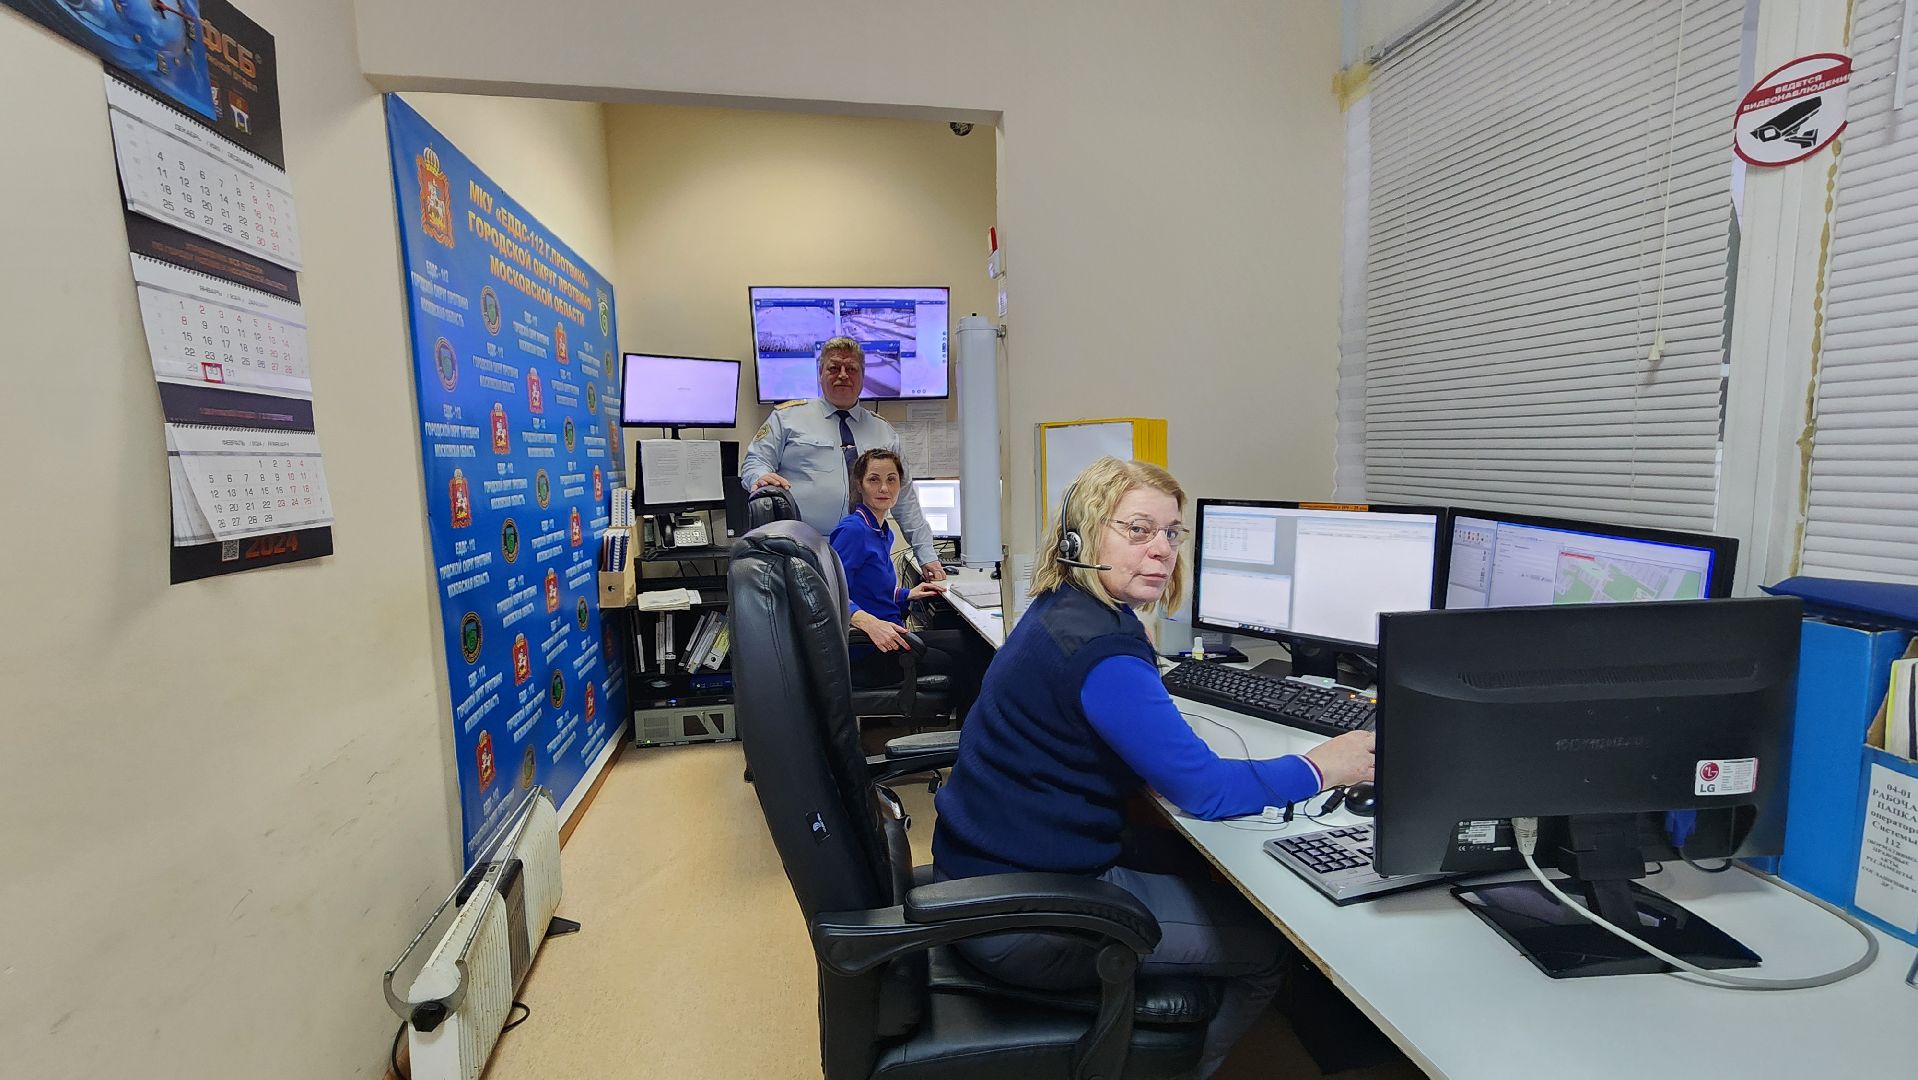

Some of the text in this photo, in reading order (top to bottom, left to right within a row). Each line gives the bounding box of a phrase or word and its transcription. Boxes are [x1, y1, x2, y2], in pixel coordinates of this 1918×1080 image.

[1743, 74, 1850, 111] ВИДЕОНАБЛЮДЕНИ
[1775, 74, 1823, 94] ВЕДЕТСЯ
[469, 179, 493, 214] МКУ
[496, 206, 544, 256] «ЕДДС-112
[468, 210, 531, 270] ГОРОДСКОЙ
[533, 258, 557, 288] ОКРУГ
[490, 254, 585, 327] МОСКОВСКОЙ ОБЛАСТИ
[245, 532, 299, 559] 2024
[1700, 784, 1715, 792] LG
[1887, 784, 1910, 798] 04-01
[1877, 801, 1917, 822] ПАПКА
[1872, 821, 1917, 845] Системы
[1886, 837, 1900, 848] 112
